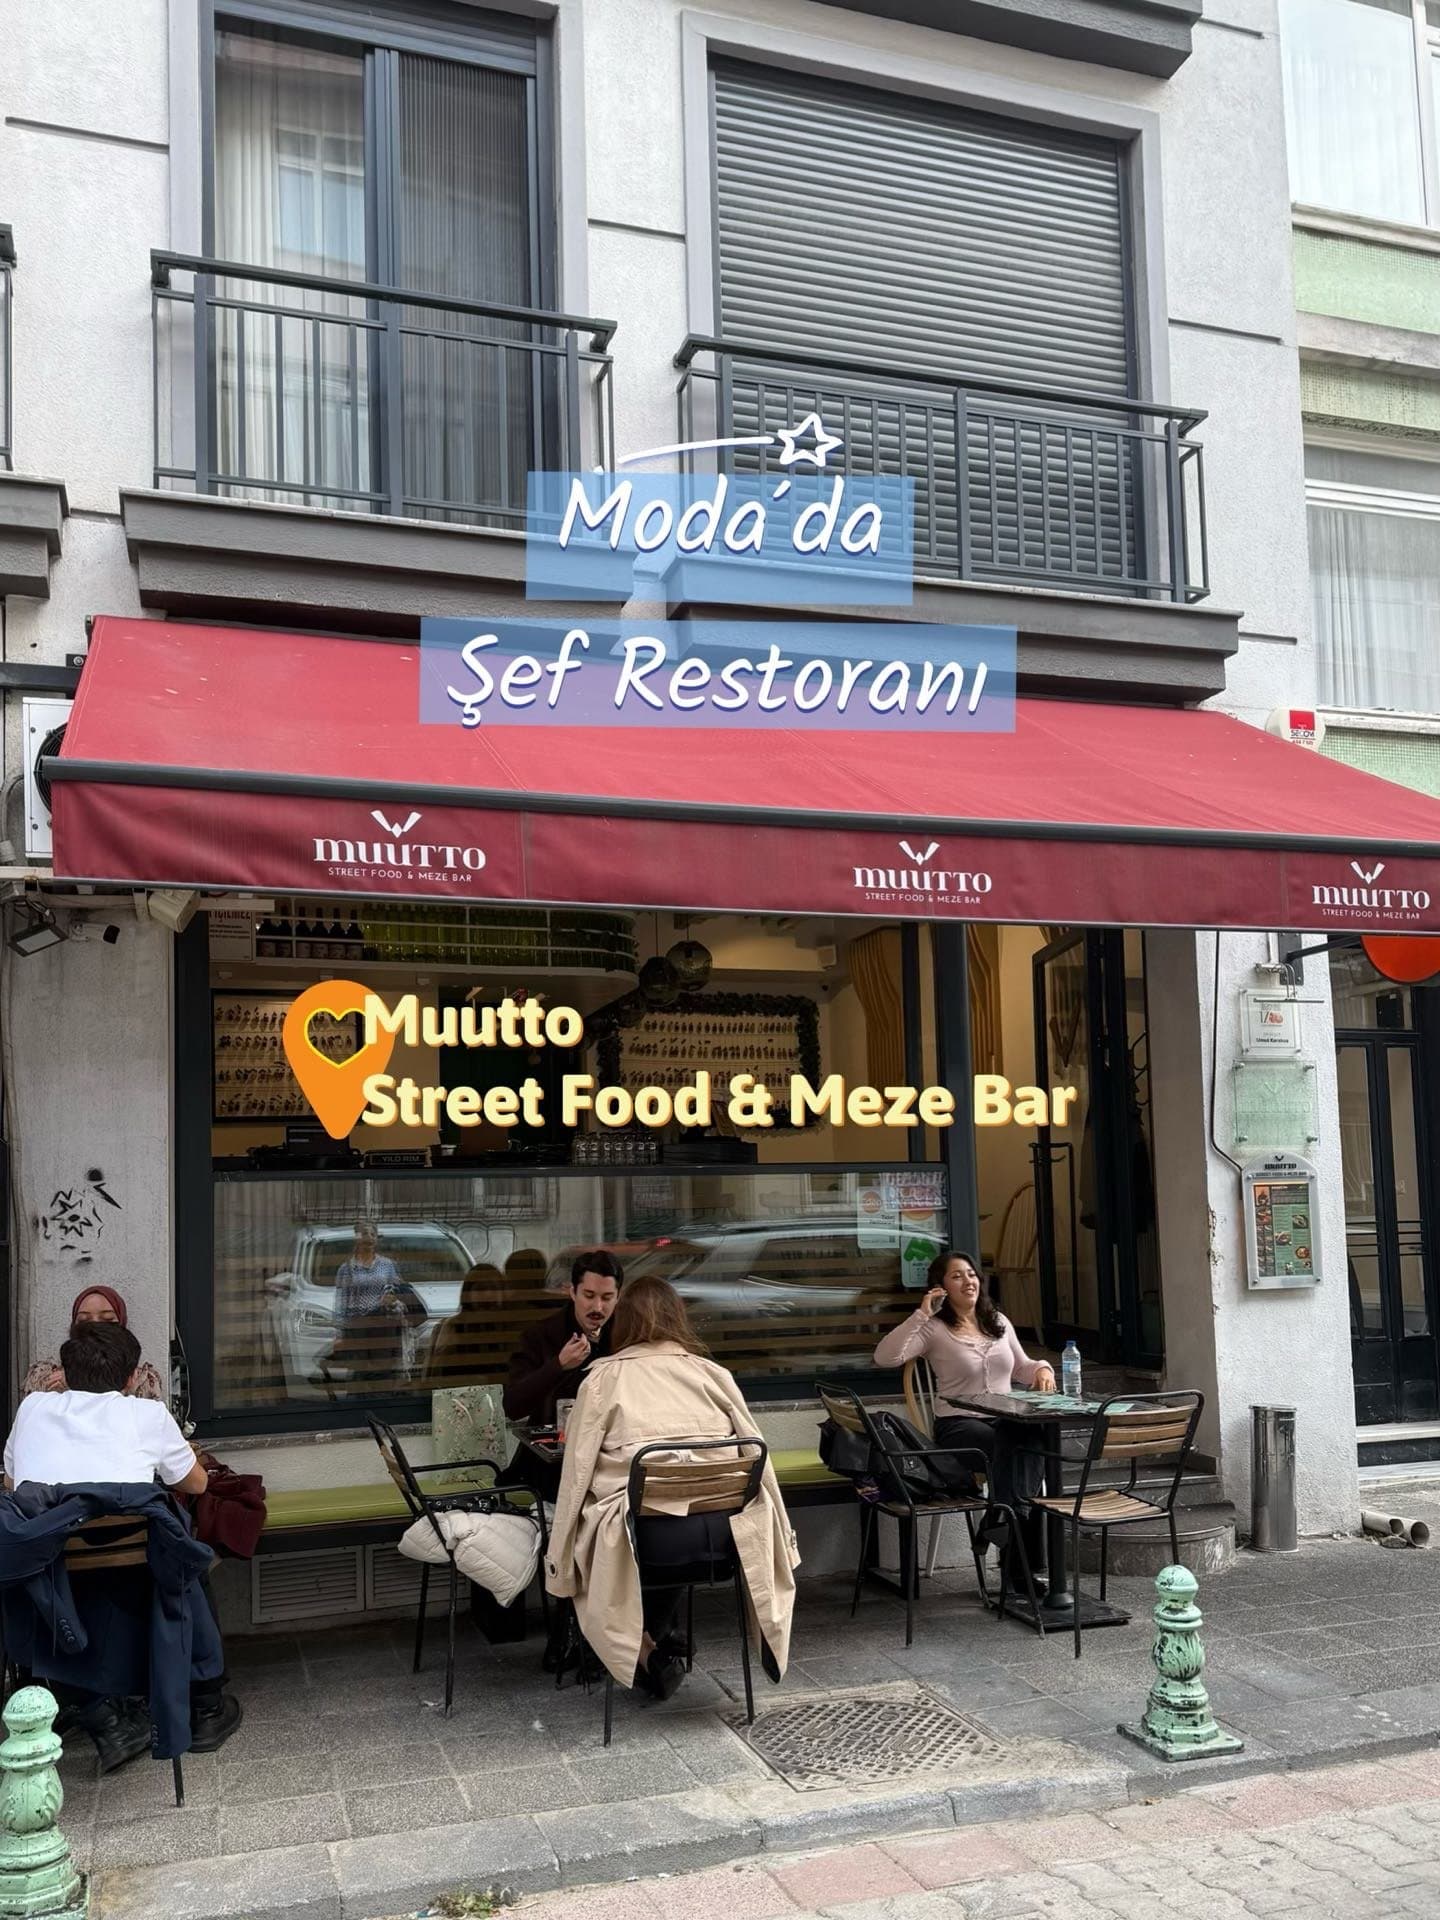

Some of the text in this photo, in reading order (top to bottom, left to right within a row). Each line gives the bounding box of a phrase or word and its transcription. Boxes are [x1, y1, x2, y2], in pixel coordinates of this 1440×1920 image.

[329, 867, 473, 883] STREET FOOD & MEZE BAR
[865, 893, 981, 904] STREET FOOD & MEZE BAR
[1322, 908, 1348, 917] STREET
[1351, 909, 1373, 918] FOOD
[1382, 911, 1404, 919] MEZE
